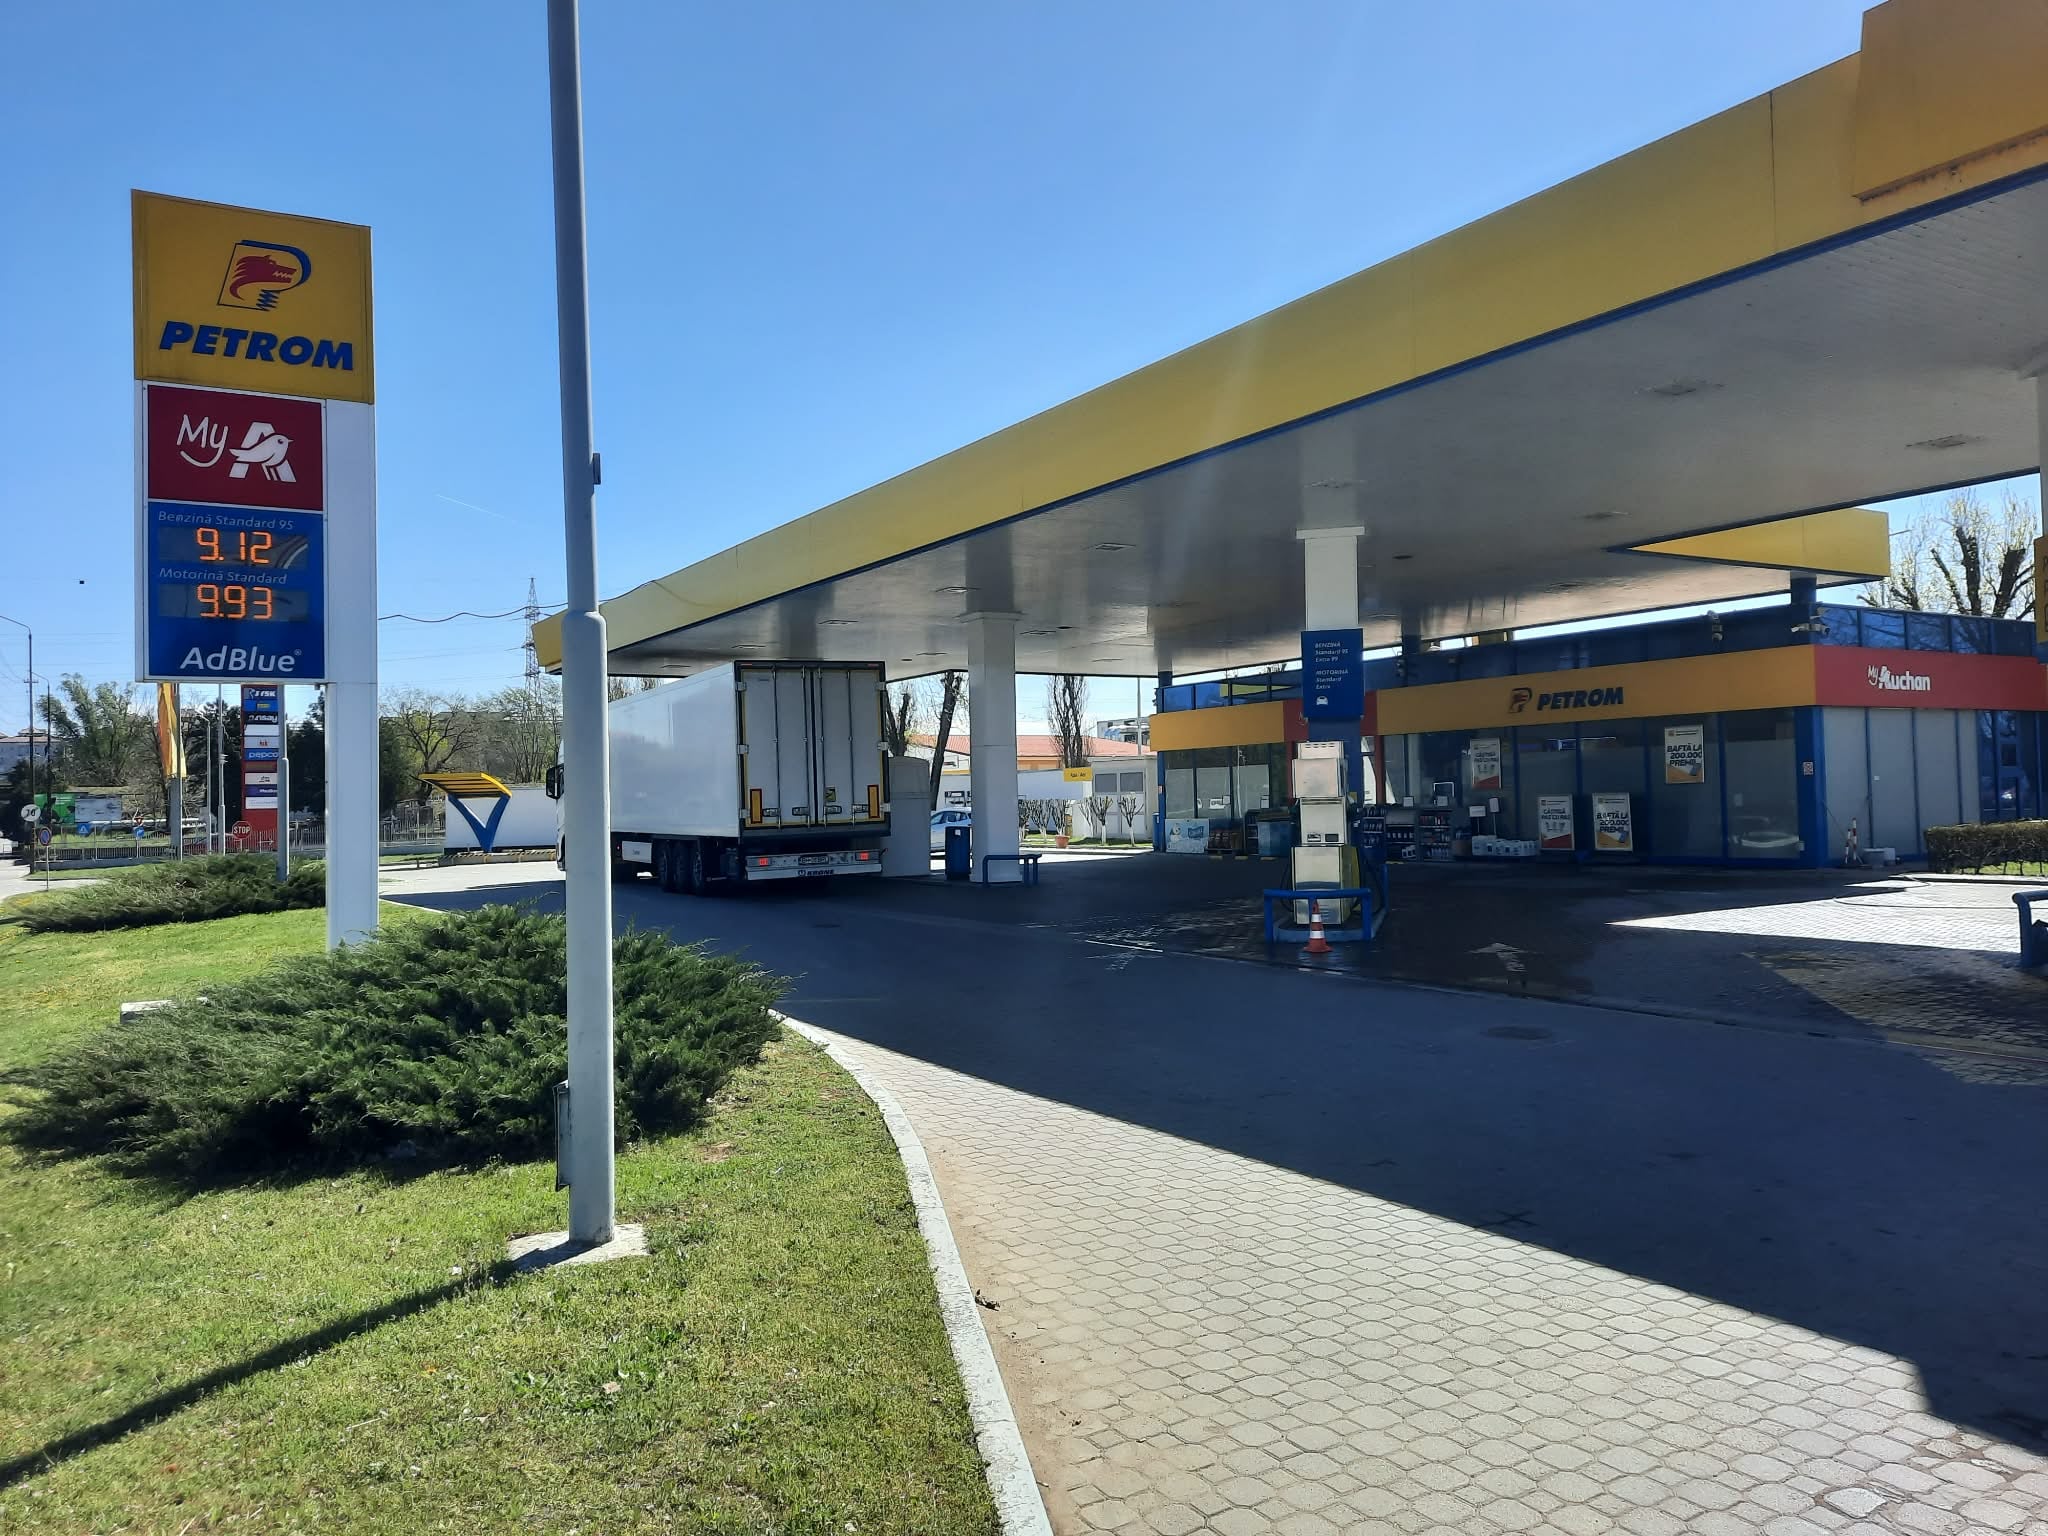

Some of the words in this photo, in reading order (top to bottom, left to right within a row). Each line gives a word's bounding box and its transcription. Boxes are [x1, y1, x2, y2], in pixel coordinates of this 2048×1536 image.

[159, 320, 353, 371] PETROM
[176, 414, 229, 468] My
[158, 511, 212, 525] Benzină
[216, 515, 275, 529] Standard
[278, 519, 294, 530] 95
[196, 527, 273, 564] 9.12
[159, 567, 224, 581] Motorină
[226, 571, 288, 585] Standard
[196, 584, 273, 620] 9.93
[1878, 665, 1931, 691] Auchan
[1537, 687, 1624, 711] PETROM
[233, 826, 251, 834] STOP
